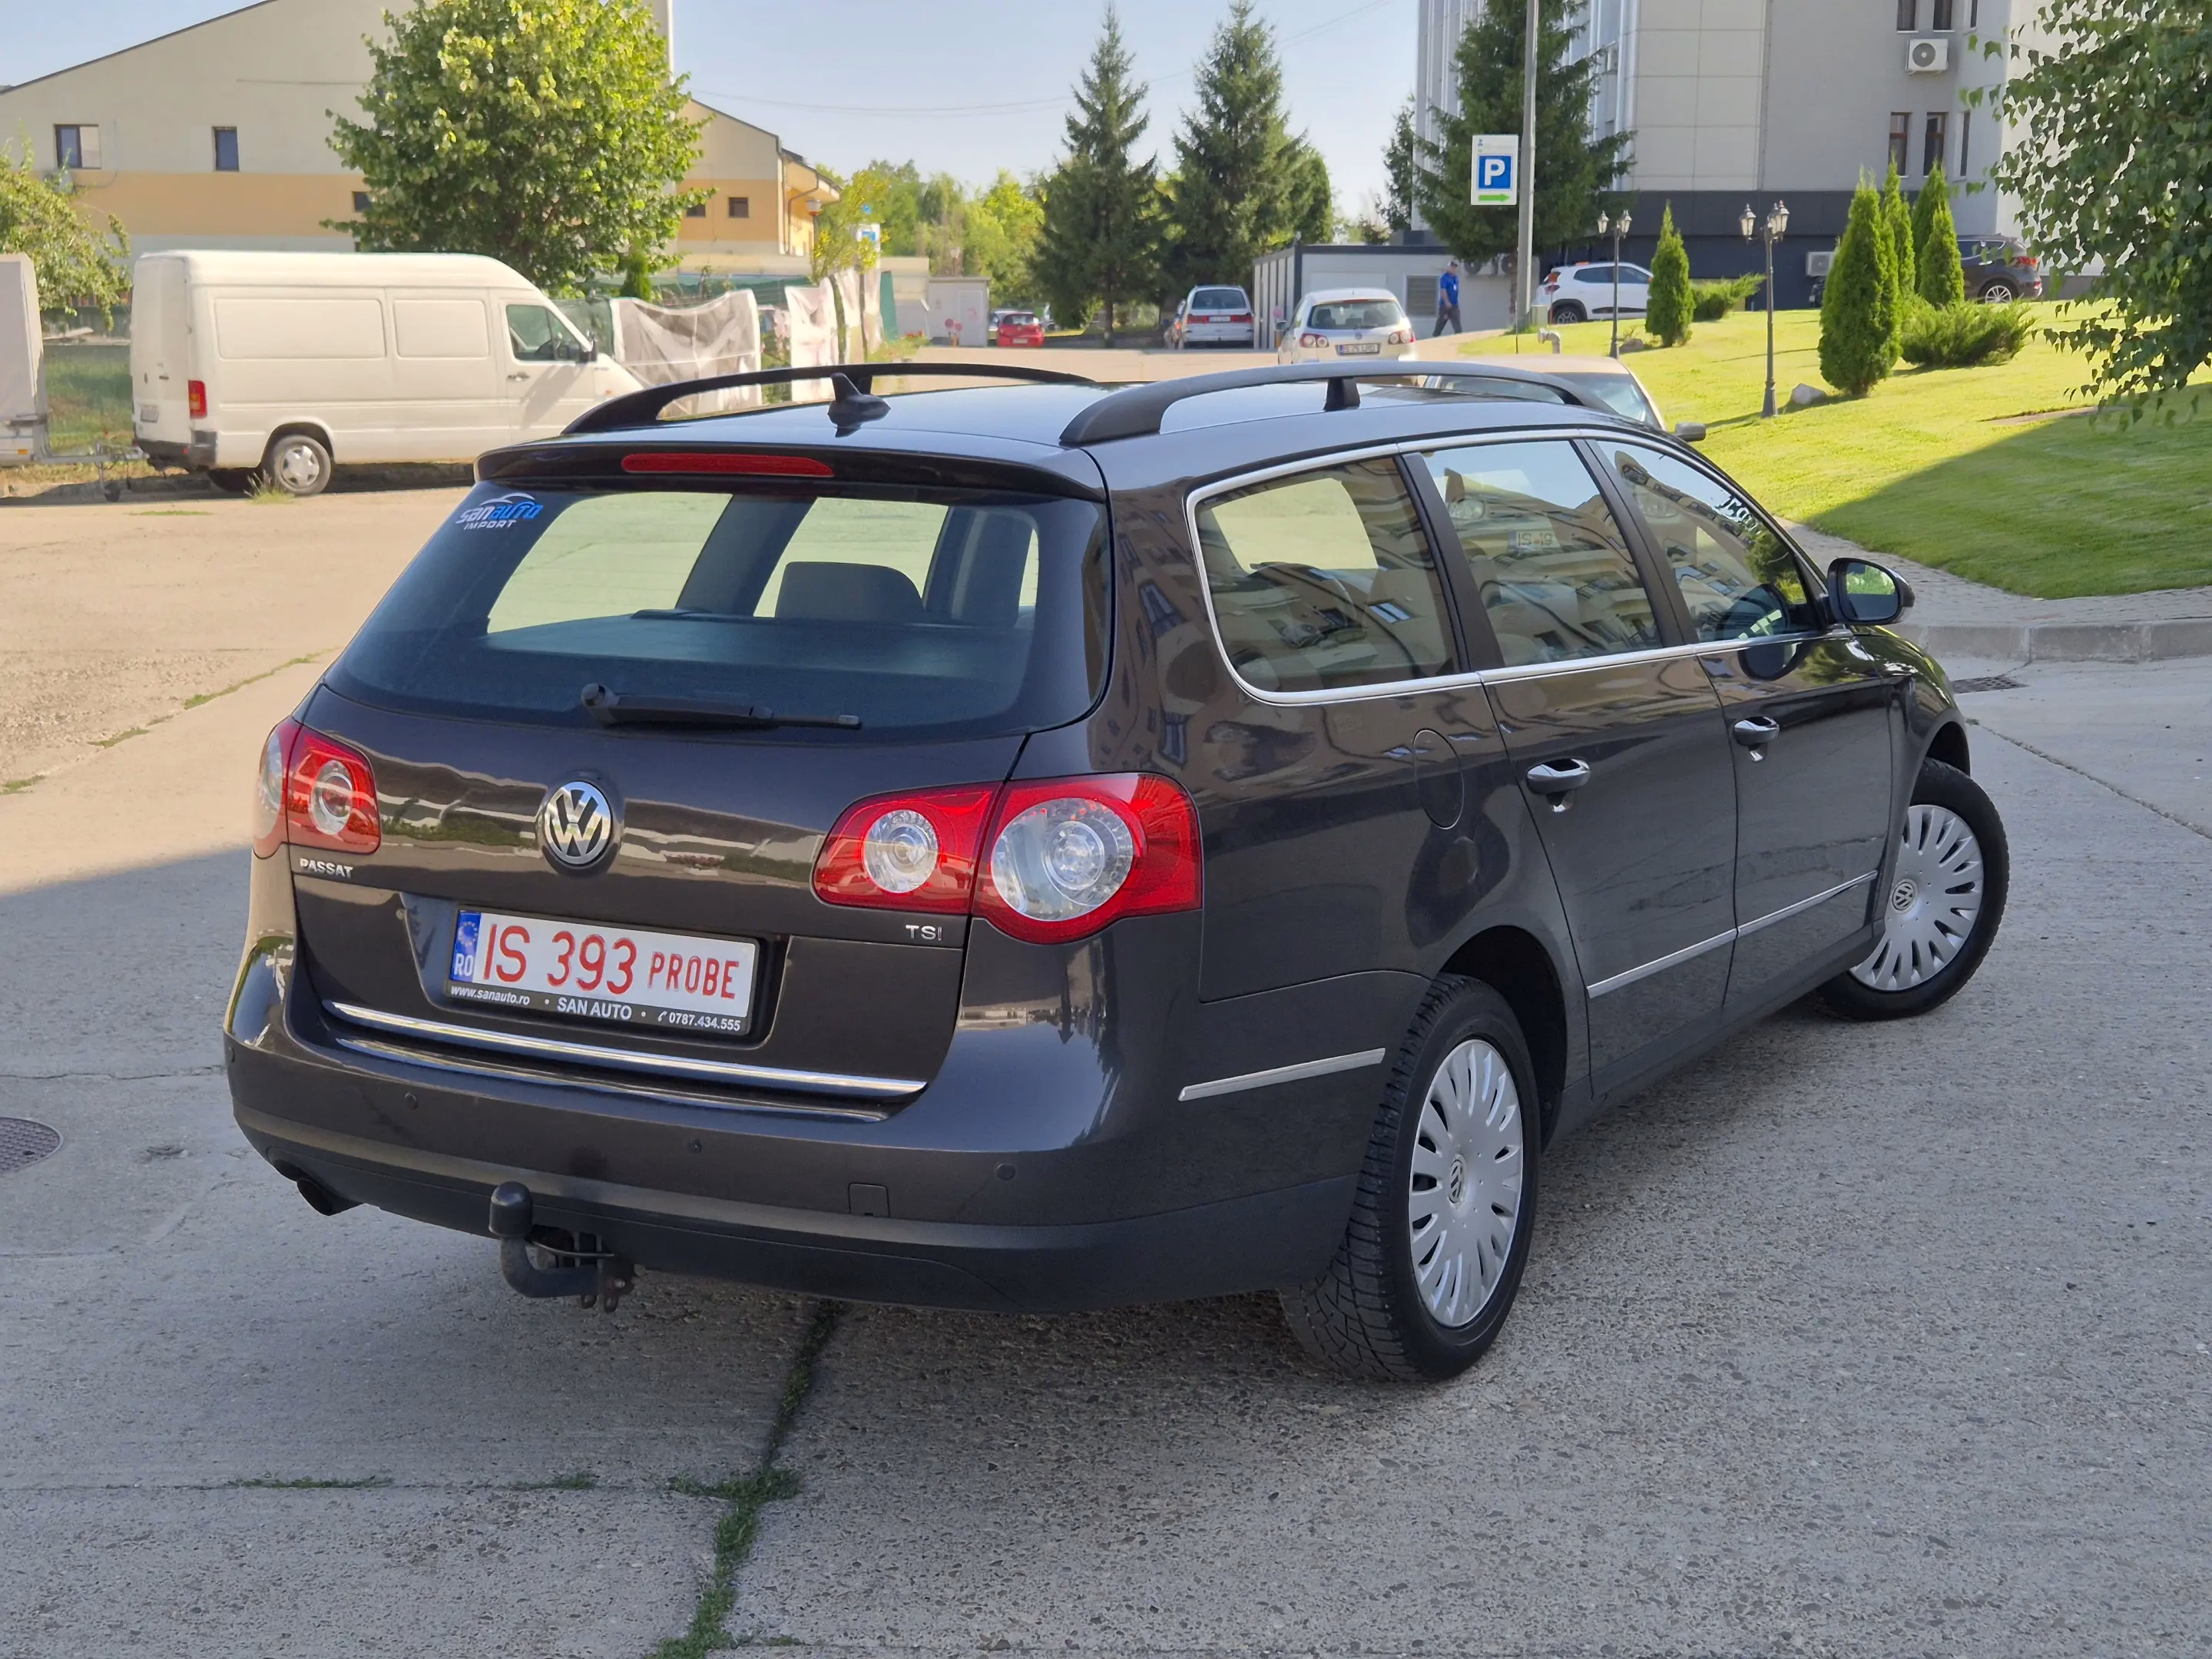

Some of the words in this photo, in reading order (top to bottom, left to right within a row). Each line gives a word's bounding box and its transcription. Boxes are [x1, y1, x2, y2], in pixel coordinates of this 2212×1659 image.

[1484, 158, 1505, 186] P
[464, 519, 517, 531] IMPORT
[300, 859, 354, 879] PASSAT
[905, 924, 942, 941] TSI
[454, 953, 474, 976] RO
[483, 923, 530, 982] IS
[547, 930, 637, 995] 393
[647, 951, 739, 999] PROBE
[451, 985, 530, 1005] www.sanauto.ro
[558, 997, 588, 1016] SAN
[590, 1002, 632, 1020] AUTO
[669, 1013, 741, 1031] 0787.434.555
